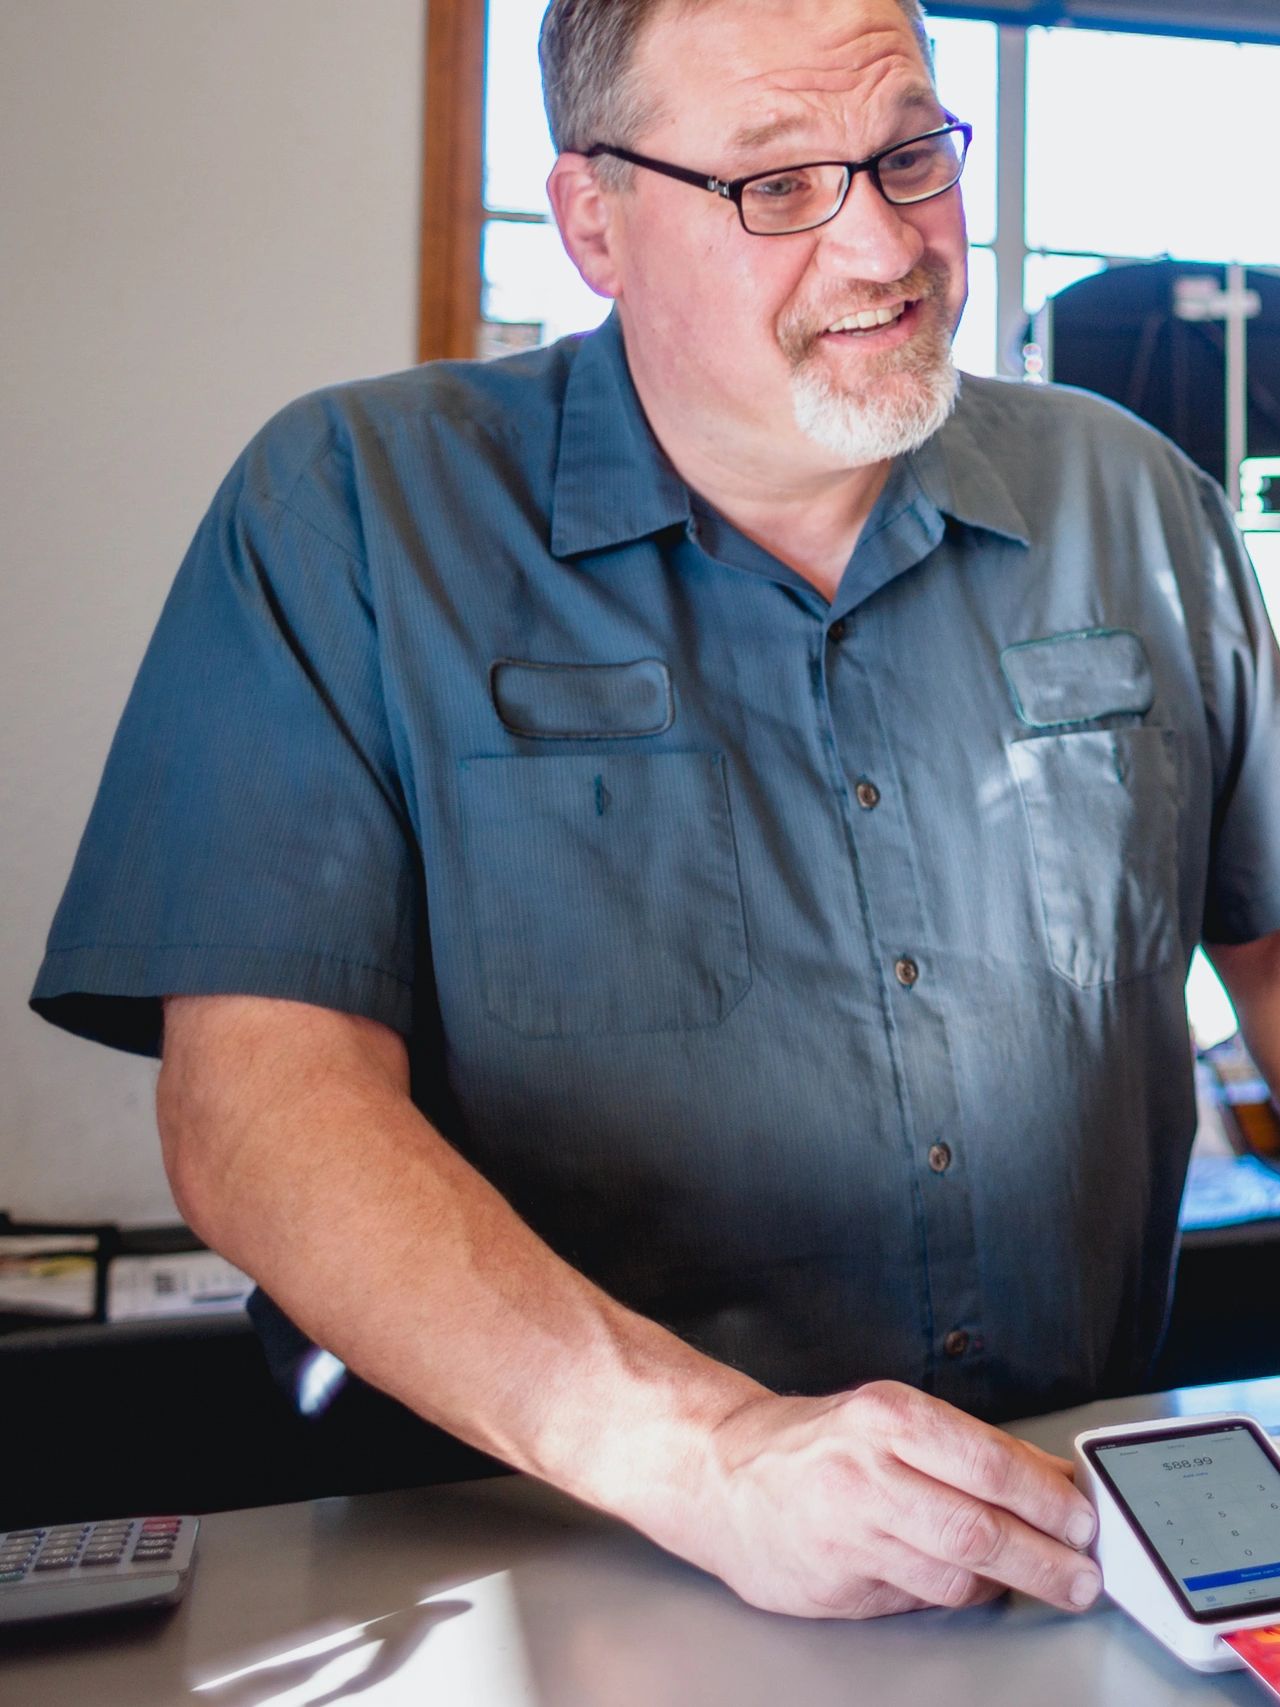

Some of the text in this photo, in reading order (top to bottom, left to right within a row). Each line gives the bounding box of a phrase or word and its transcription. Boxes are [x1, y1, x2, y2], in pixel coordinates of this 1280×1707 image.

[1162, 1456, 1213, 1471] $88.99
[1257, 1484, 1265, 1492] 3
[1205, 1492, 1214, 1500] 2
[1270, 1502, 1279, 1510] 6
[1231, 1529, 1240, 1537] 8
[1177, 1538, 1184, 1546] 7
